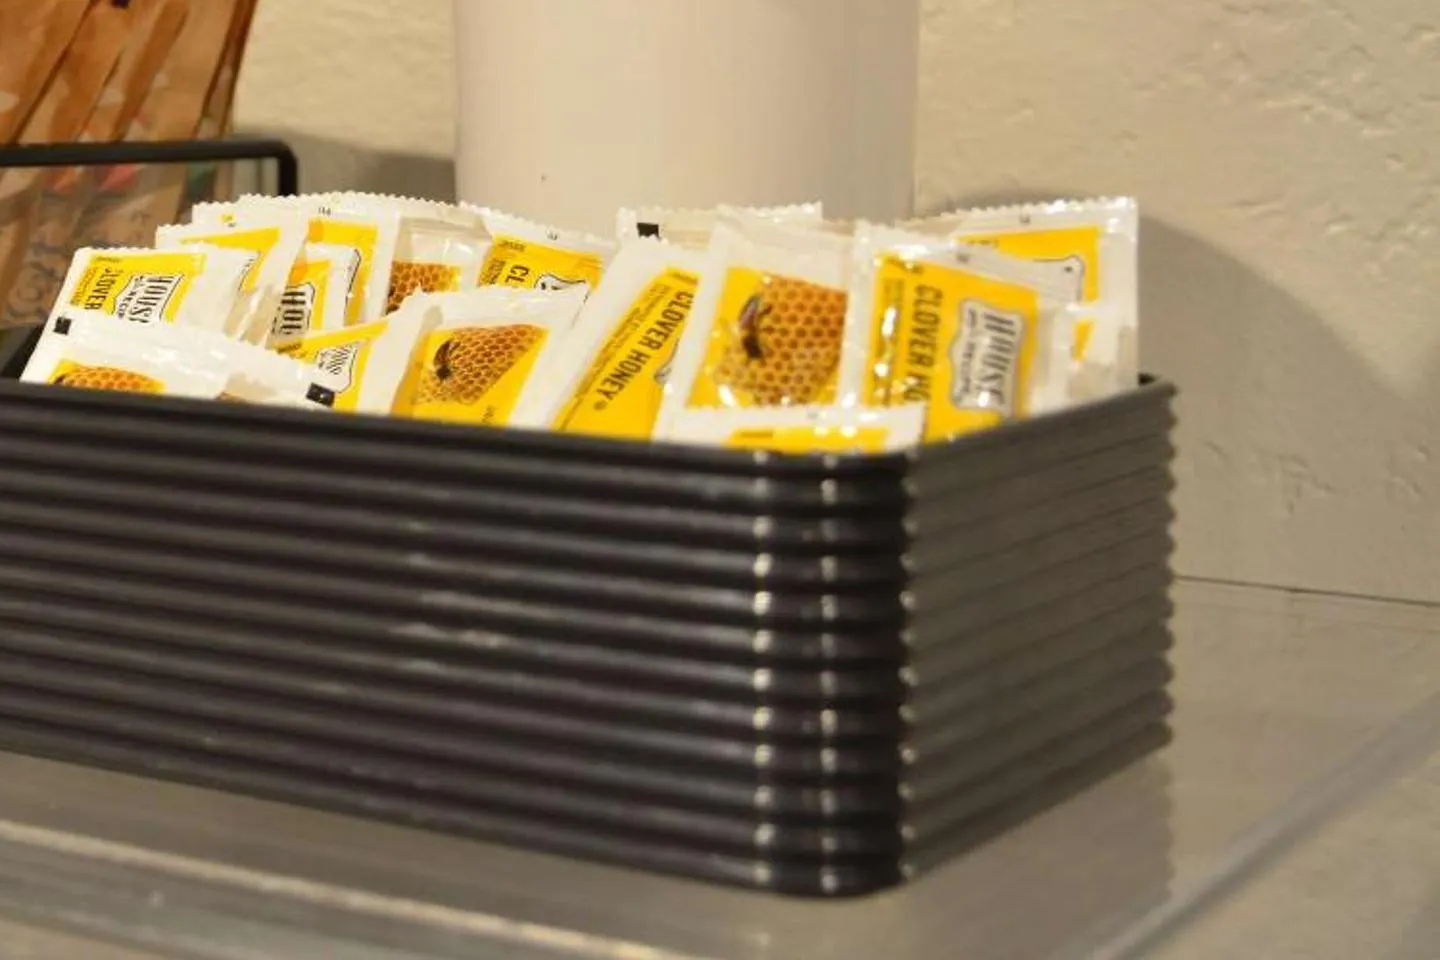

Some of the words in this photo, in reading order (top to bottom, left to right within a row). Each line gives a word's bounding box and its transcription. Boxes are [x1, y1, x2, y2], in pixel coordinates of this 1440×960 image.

[637, 291, 694, 350] CLOVER
[906, 284, 943, 368] CLOVER
[596, 348, 652, 401] HONEY
